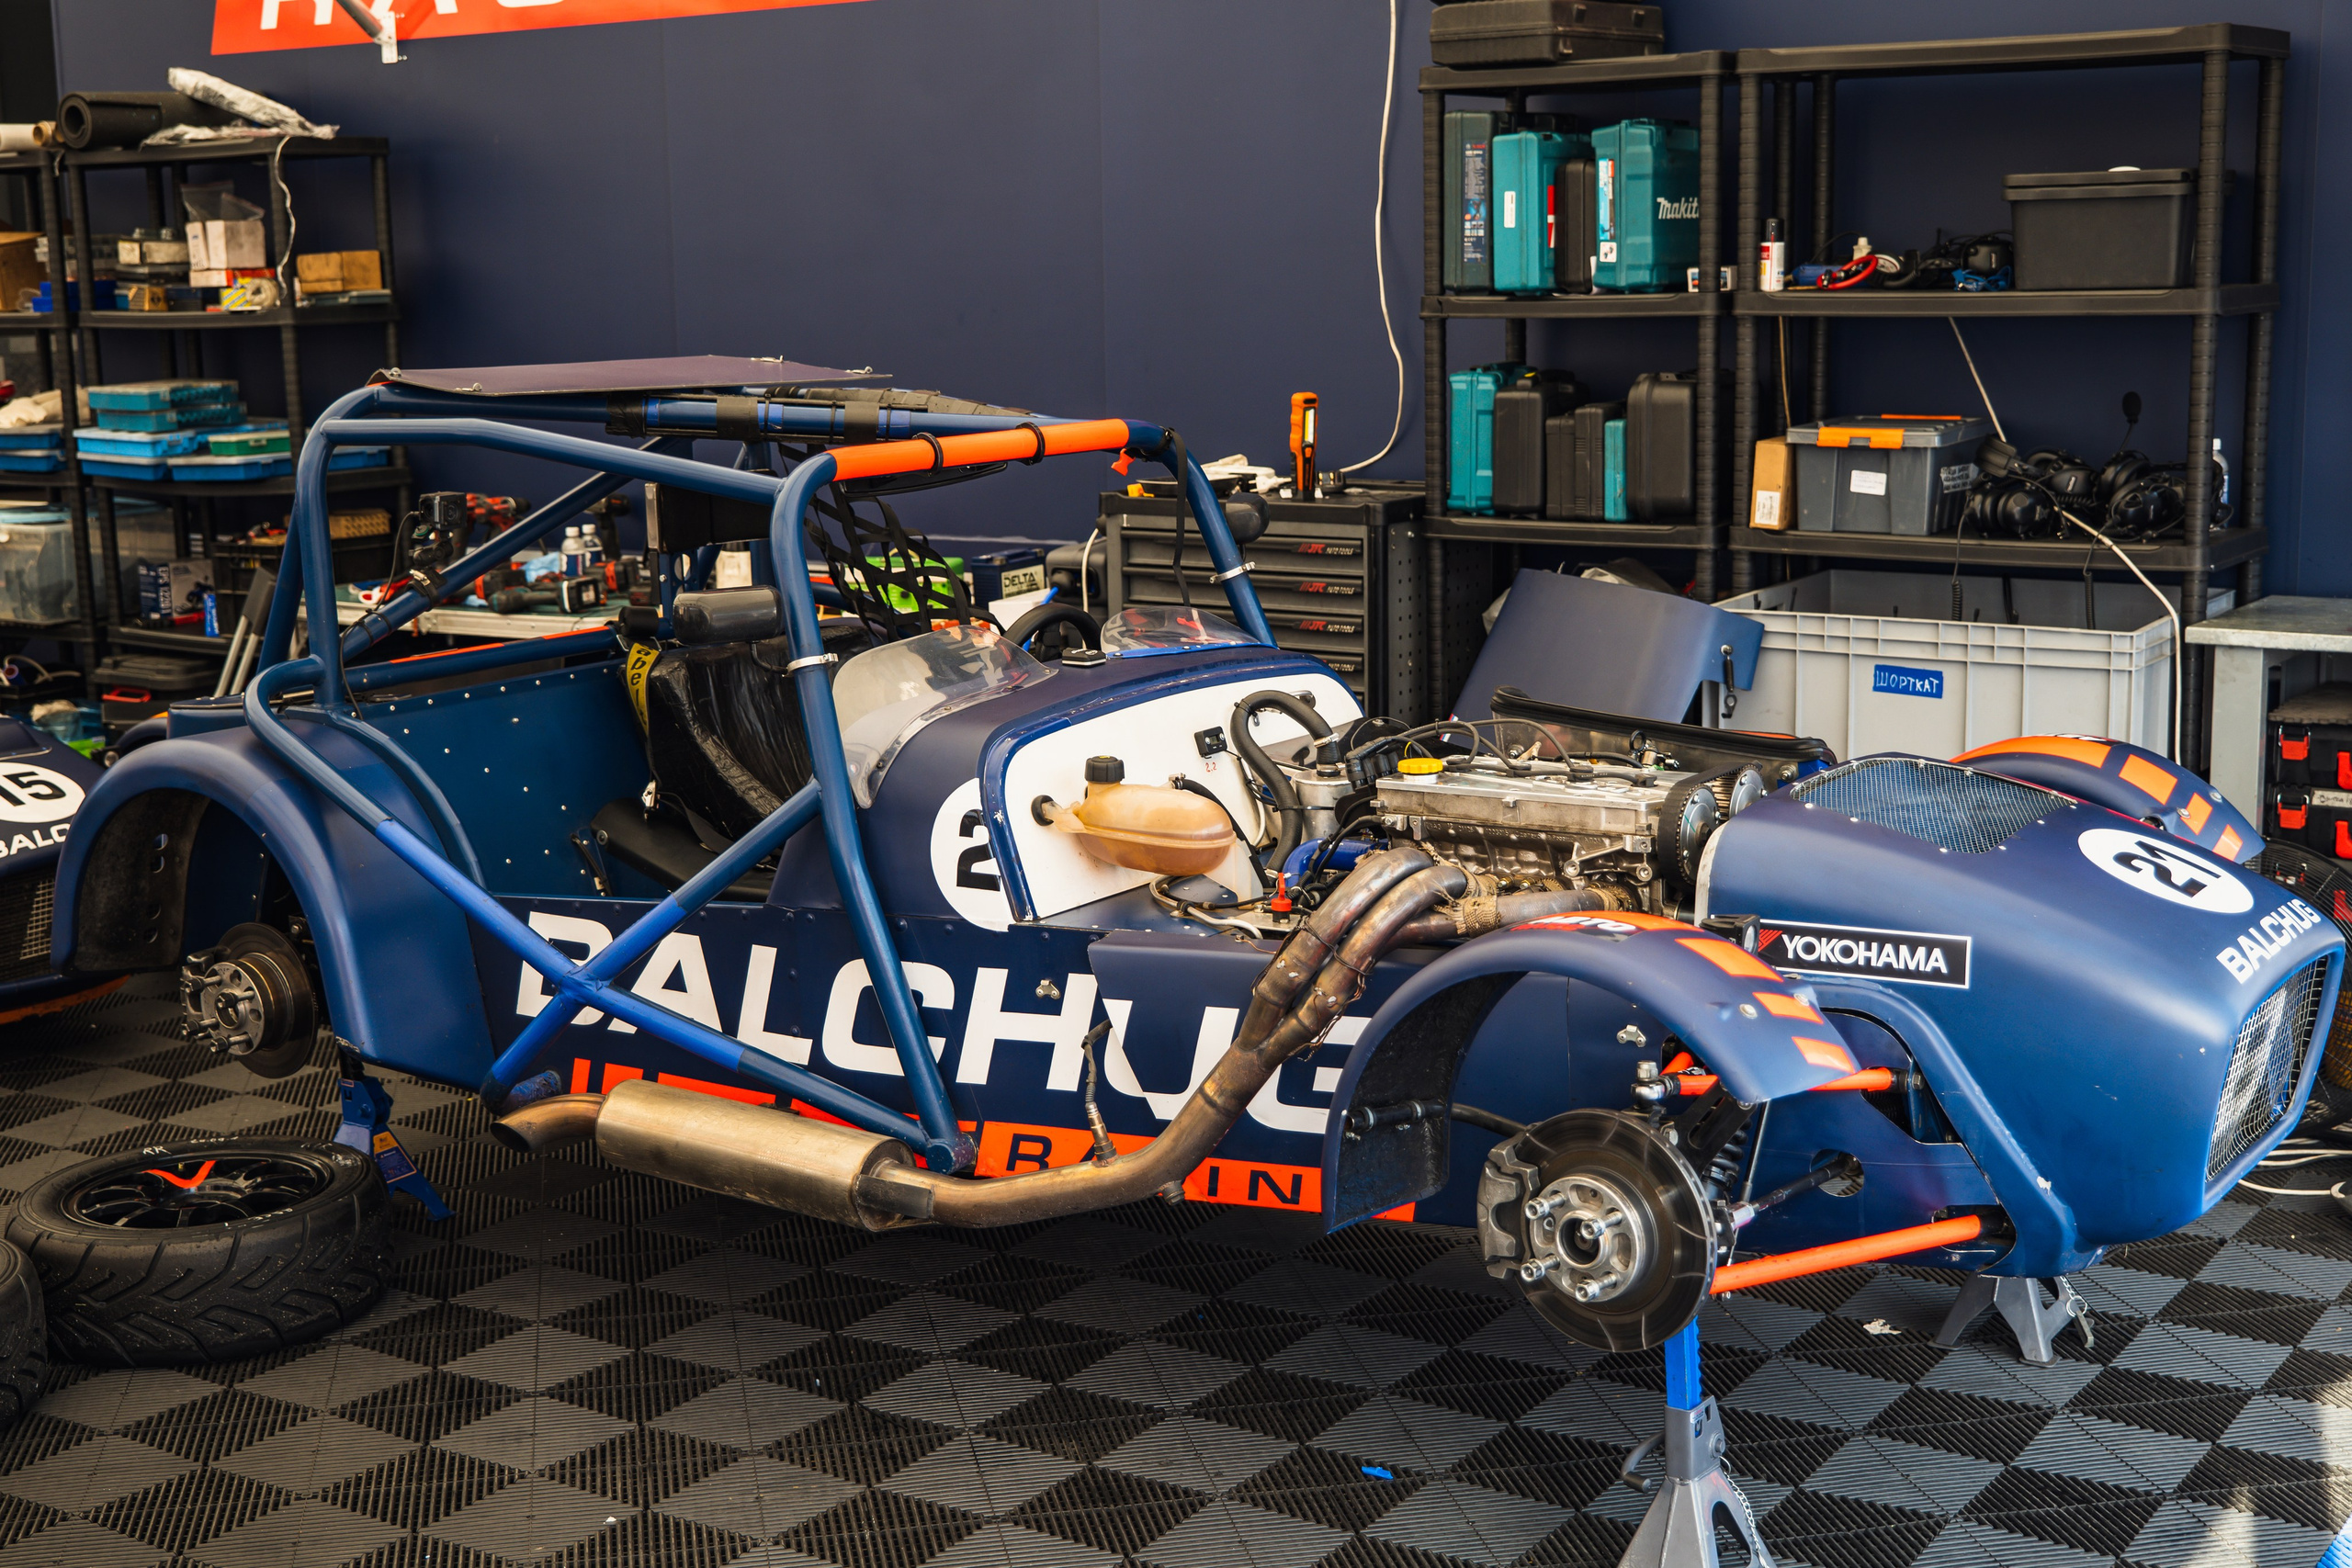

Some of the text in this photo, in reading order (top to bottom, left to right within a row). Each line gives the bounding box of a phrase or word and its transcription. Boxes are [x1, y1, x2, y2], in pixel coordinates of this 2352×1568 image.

[1657, 197, 1699, 220] Makit
[1307, 543, 1354, 556] JTC AUTO TOOLS
[1003, 571, 1036, 588] DELTA
[1308, 581, 1355, 595] JTC AUTO TOOLS
[1308, 620, 1328, 631] JTC
[1340, 625, 1355, 633] TOOLS
[1340, 663, 1355, 671] TOOLS
[1875, 670, 1940, 694] ШОРТКАТ
[1204, 761, 1217, 773] 2.2
[2113, 840, 2222, 898] 21
[2215, 897, 2323, 985] BALCHUG
[1781, 932, 1949, 974] YOKOHAMA
